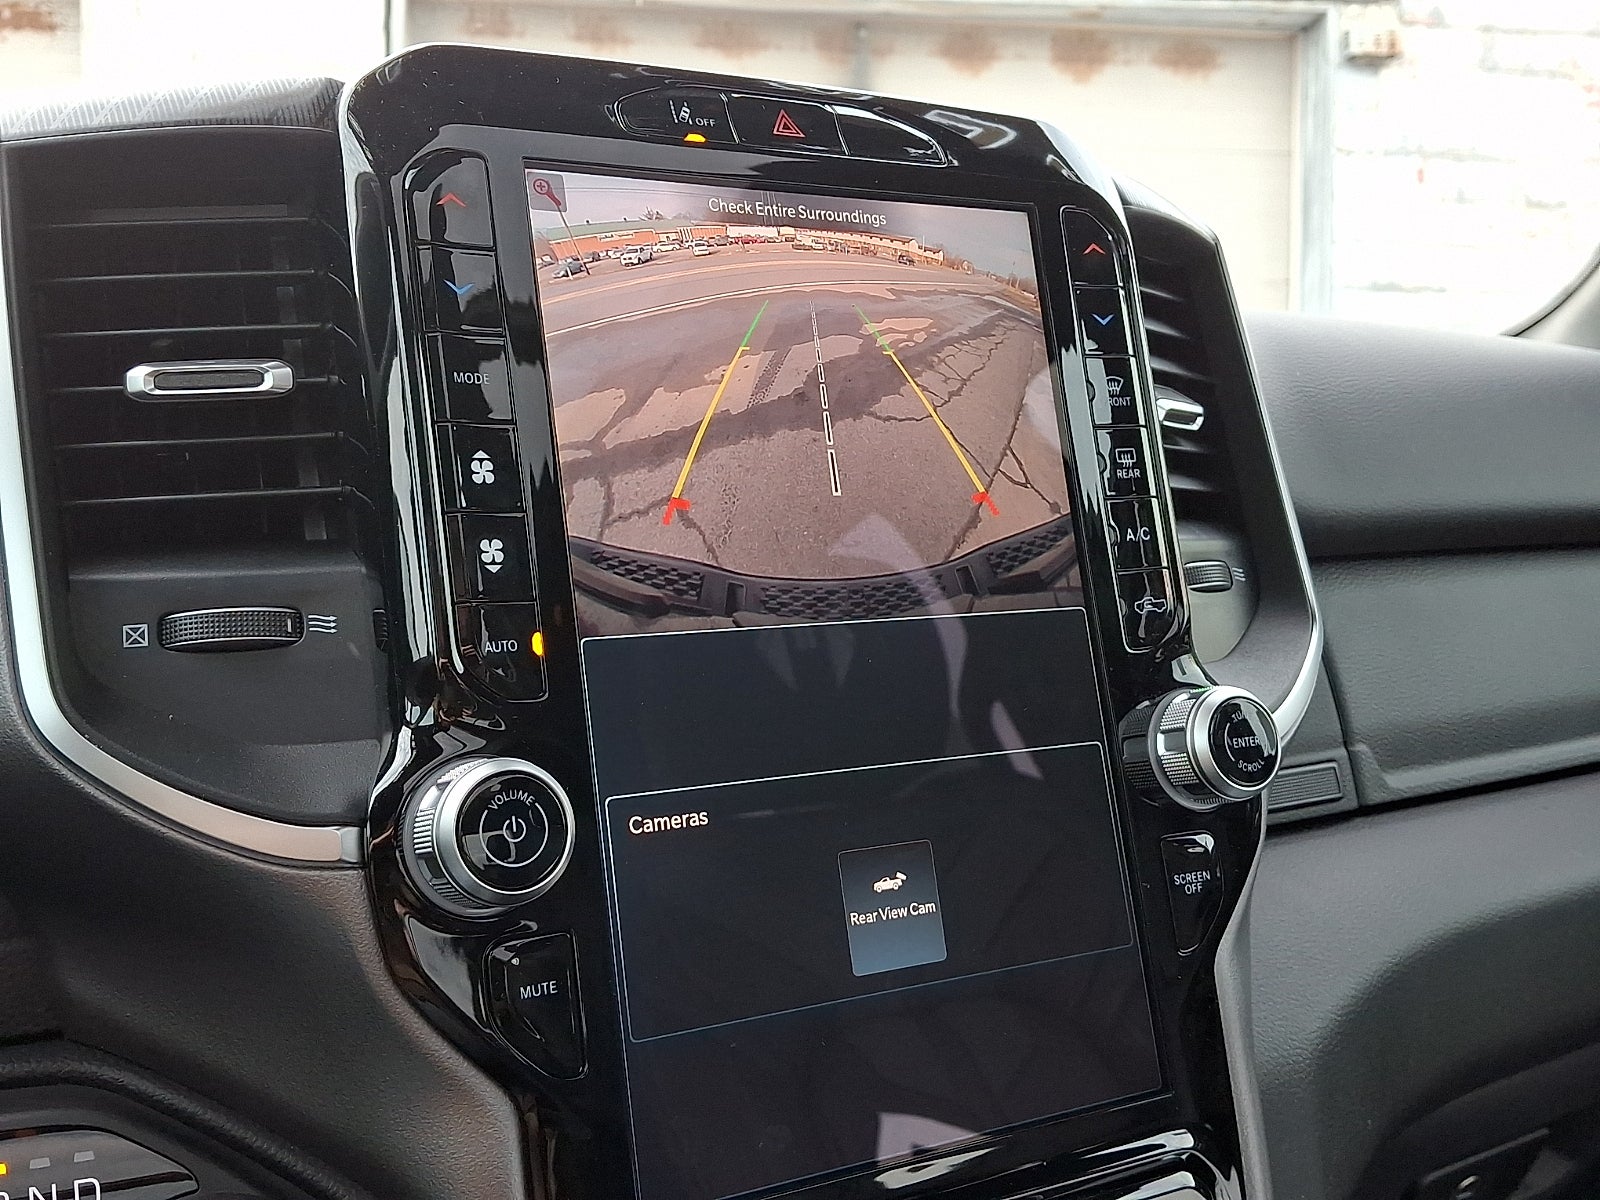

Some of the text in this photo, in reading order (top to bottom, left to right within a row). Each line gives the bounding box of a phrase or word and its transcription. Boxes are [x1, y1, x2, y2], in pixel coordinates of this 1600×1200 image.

[695, 117, 716, 127] OFF
[708, 197, 887, 228] Check Entire Surroundings
[453, 371, 490, 385] MODE
[1116, 468, 1141, 479] REAR
[1126, 526, 1151, 542] A/C
[484, 639, 518, 653] AUTO
[1232, 735, 1261, 749] ENTER
[1237, 758, 1265, 773] SCROLL
[487, 788, 536, 810] VOLUME
[628, 811, 709, 835] Cameras
[1173, 870, 1211, 886] SCREEN
[1184, 882, 1203, 895] OFF
[849, 902, 936, 926] Rear View Cam
[519, 980, 558, 1000] MUTE
